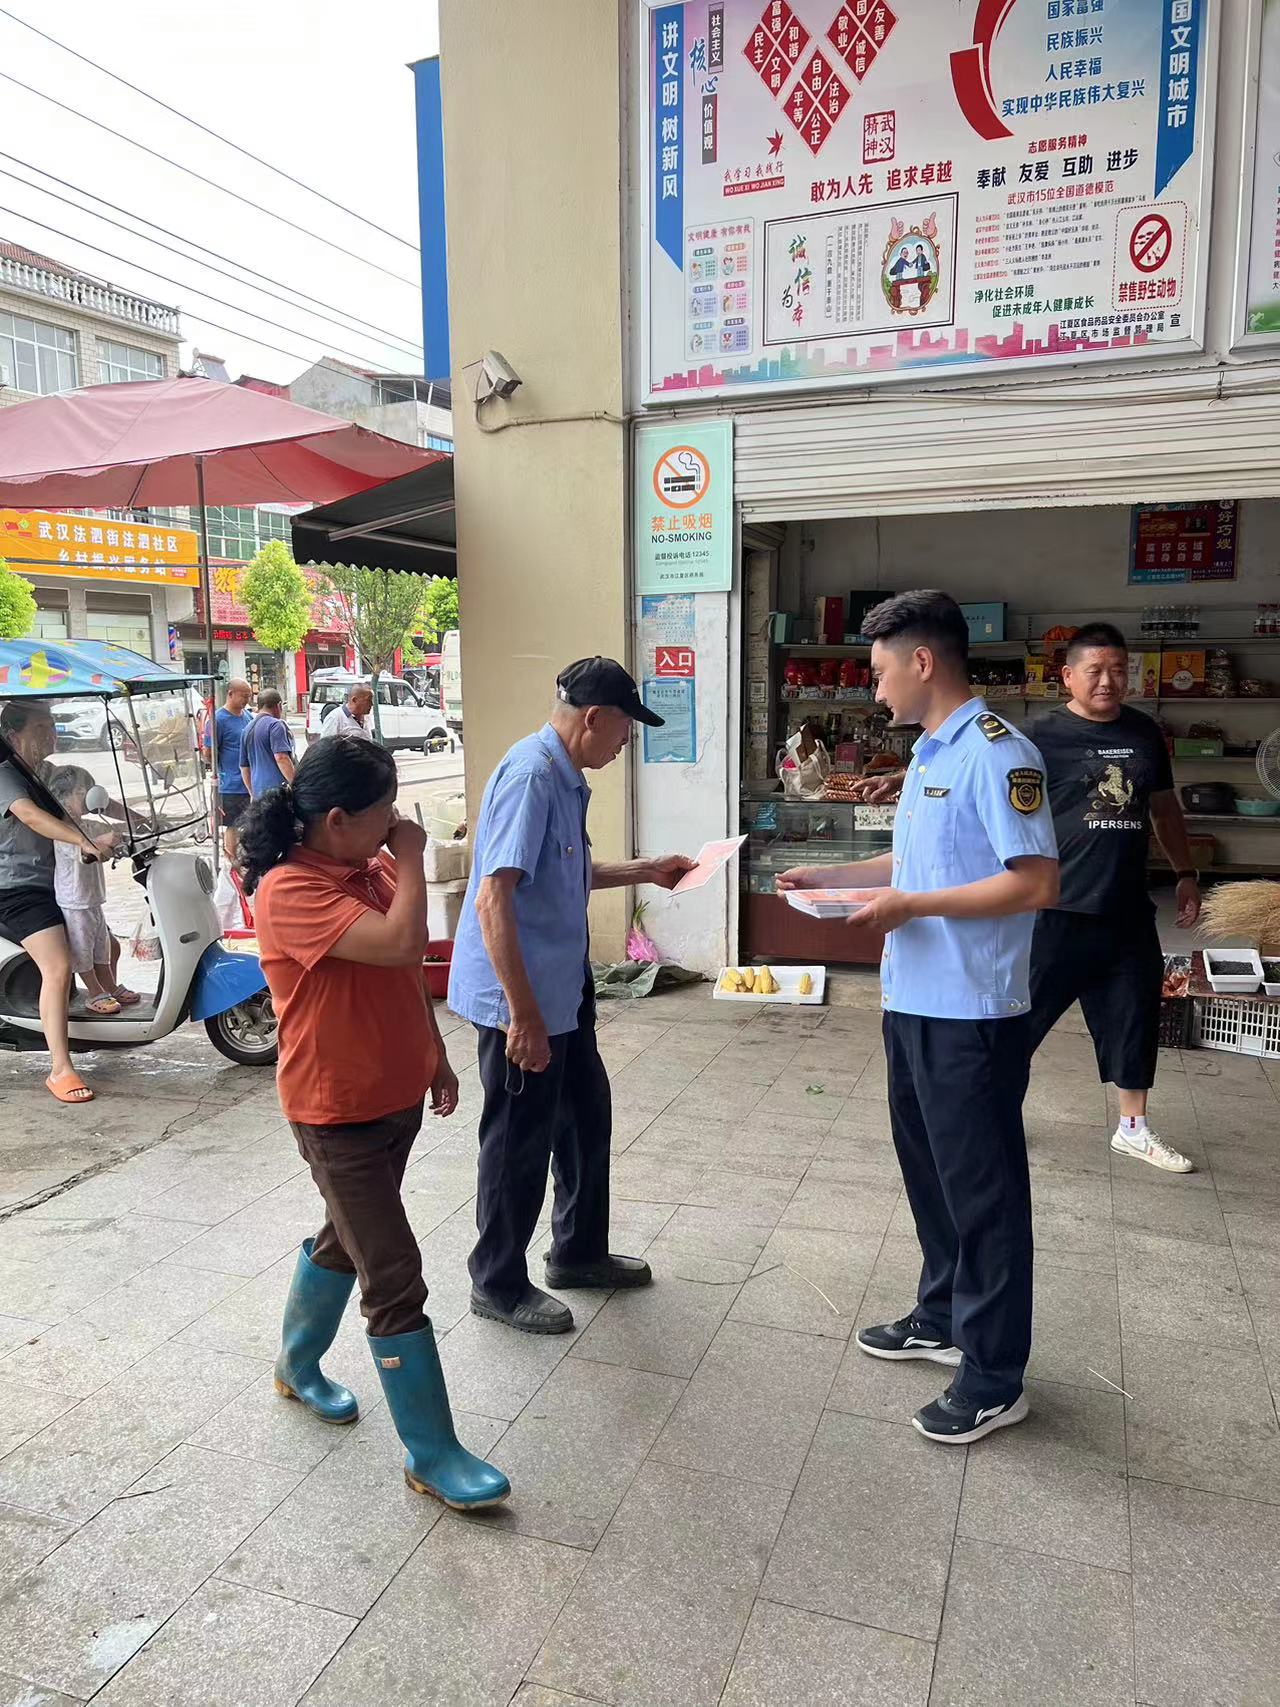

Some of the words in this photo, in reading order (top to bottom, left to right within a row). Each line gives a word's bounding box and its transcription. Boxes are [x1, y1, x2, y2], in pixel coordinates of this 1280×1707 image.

[771, 0, 782, 33] 富强
[874, 7, 885, 42] 友善
[1047, 0, 1104, 19] 国家富强
[711, 14, 721, 63] 社会主义
[754, 32, 765, 65] 民主
[788, 26, 799, 61] 和谐
[837, 15, 849, 50] 敬业
[1046, 26, 1104, 53] 民族振兴
[661, 22, 679, 107] 讲文明
[770, 56, 781, 89] 文明
[855, 40, 867, 74] 诚信
[1045, 57, 1103, 83] 人民幸福
[811, 58, 822, 92] 自由
[793, 90, 804, 123] 平等
[828, 82, 840, 115] 法治
[1002, 79, 1146, 117] 实现中华民族伟大复兴
[703, 103, 714, 152] 价值观
[810, 112, 821, 146] 公正
[1028, 134, 1088, 154] 志愿服务精神
[661, 115, 679, 201] 树新风
[976, 166, 1006, 190] 奉献
[1019, 160, 1050, 184] 友爱
[1061, 154, 1094, 178] 互助
[1105, 148, 1139, 173] 进步
[811, 174, 873, 203] 敢为人先
[886, 160, 953, 192] 追求卓越
[1007, 180, 1115, 206] 武汉市15位全国道德模范
[974, 284, 1035, 304] 净化社会环境
[992, 295, 1095, 319] 促进未成年人健康成长
[1118, 277, 1177, 304] 禁售野生动物
[1060, 311, 1165, 329] 江夏区食品药品安全委员会办公室
[1170, 314, 1181, 327] 宣
[651, 513, 713, 532] 禁止吸烟
[651, 531, 712, 544] NO-SMOKING
[659, 651, 692, 667] 入口
[1088, 820, 1143, 830] IPERSENS
